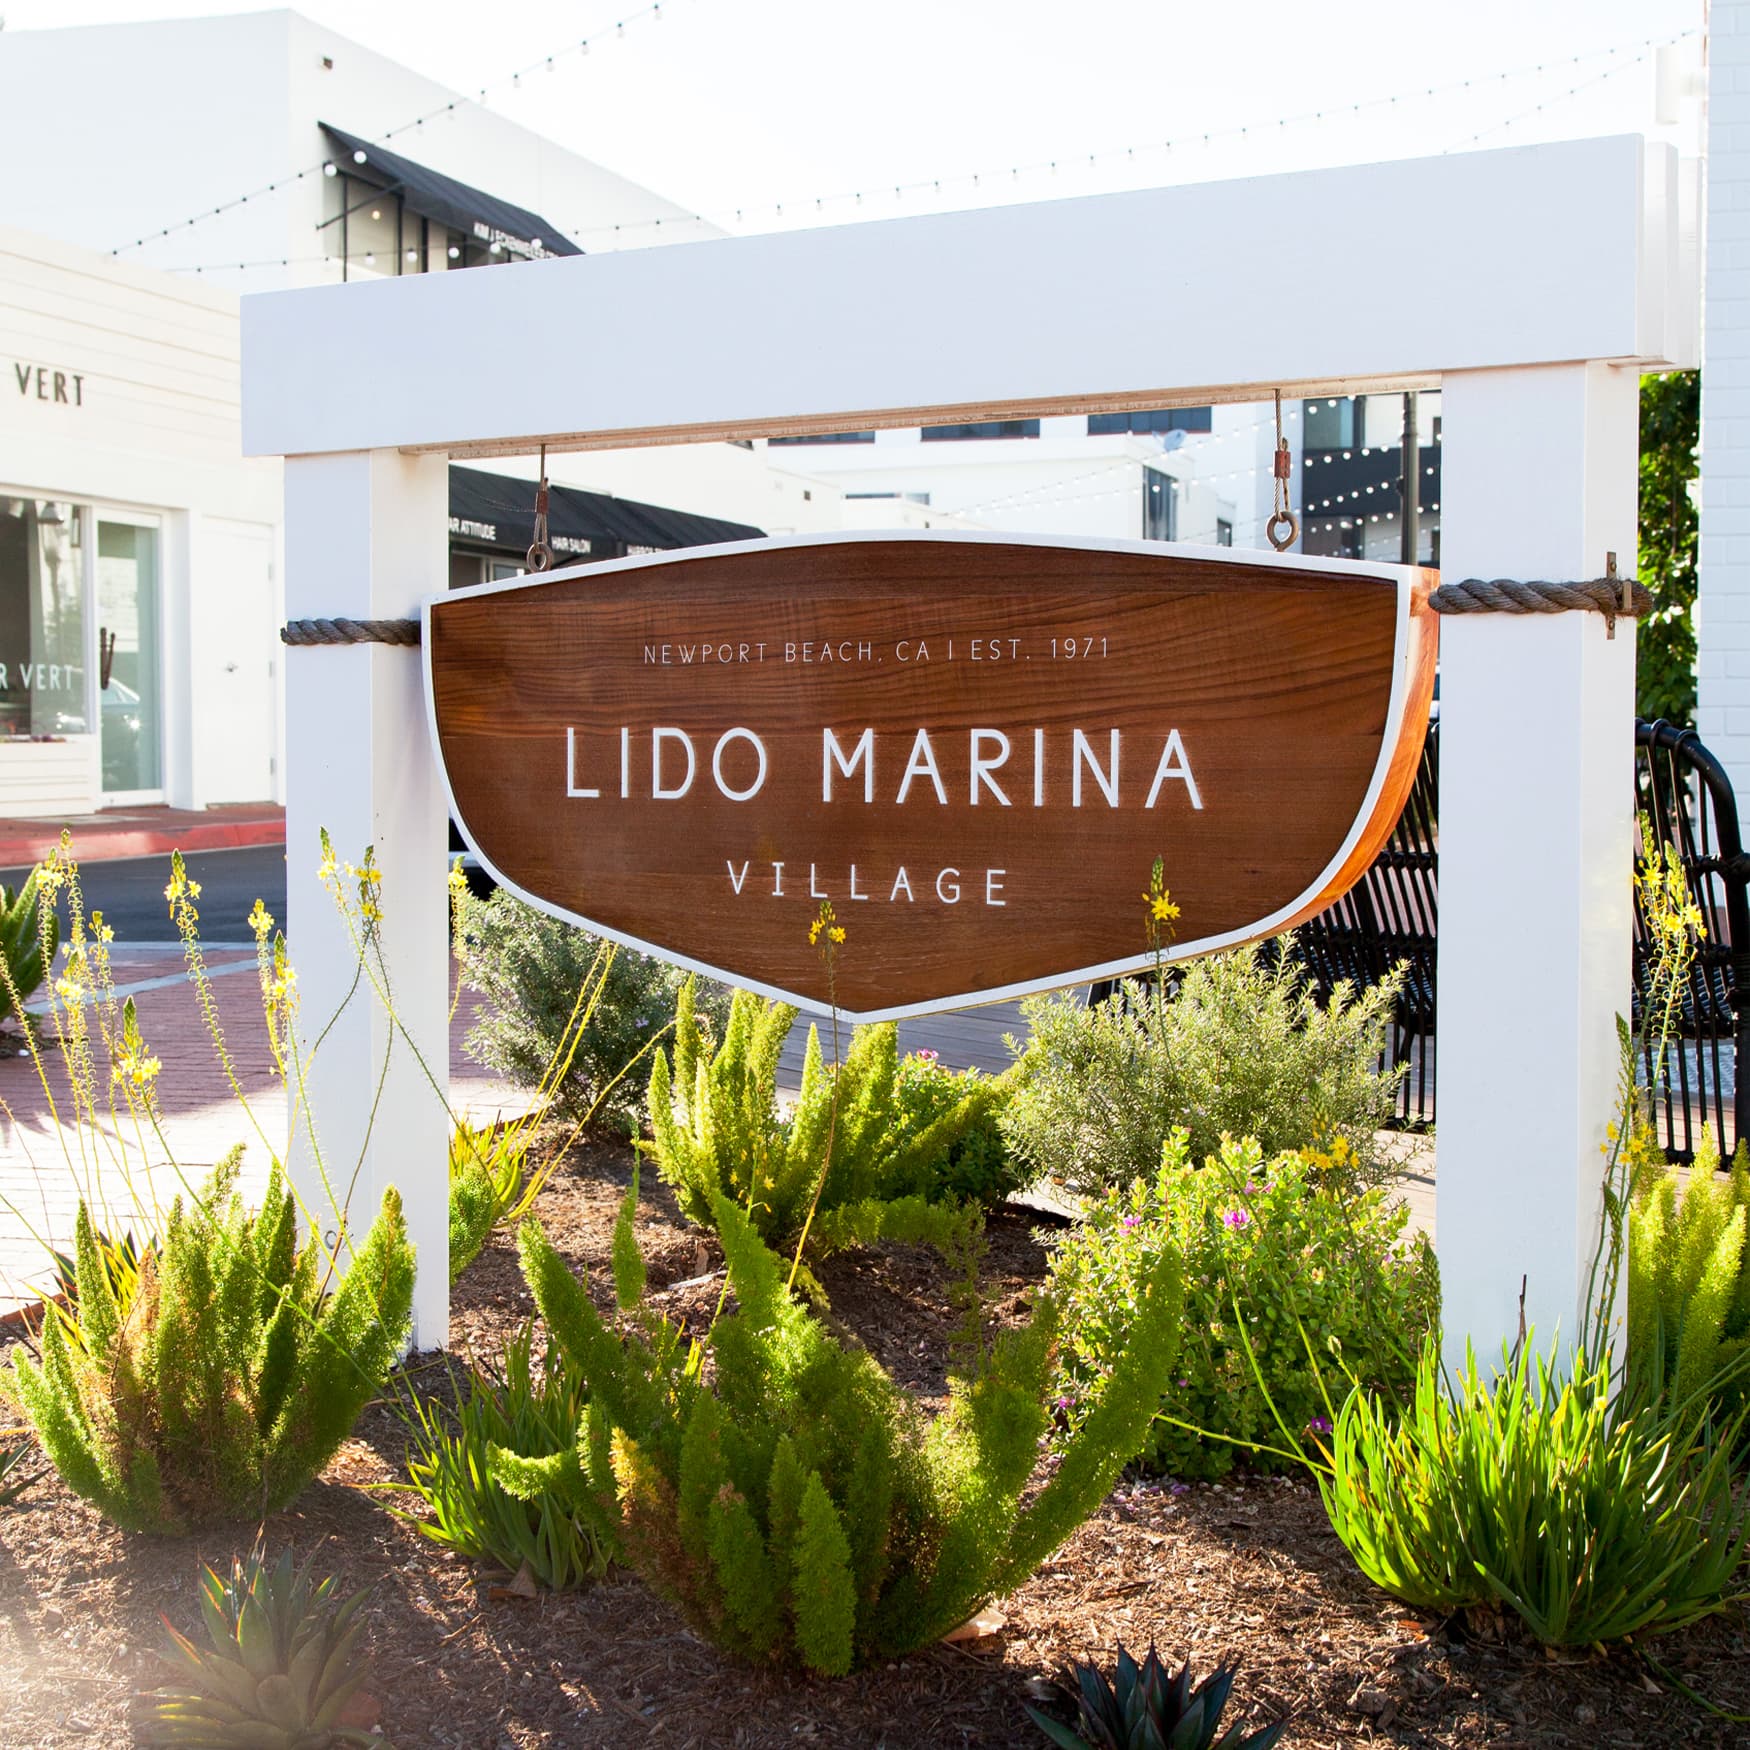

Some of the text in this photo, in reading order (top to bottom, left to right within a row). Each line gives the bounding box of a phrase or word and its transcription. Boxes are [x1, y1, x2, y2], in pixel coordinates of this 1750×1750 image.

[15, 363, 84, 406] VERT
[461, 520, 496, 540] ATTITUDE
[551, 536, 591, 553] HAIR SALON
[644, 643, 767, 664] NEWPORT
[896, 640, 930, 662] CA
[970, 638, 1031, 661] EST.
[1050, 637, 1109, 660] 1971
[19, 663, 73, 690] VERT
[566, 727, 1203, 810] LIDO MARINA
[726, 859, 1007, 906] VILLAGE
